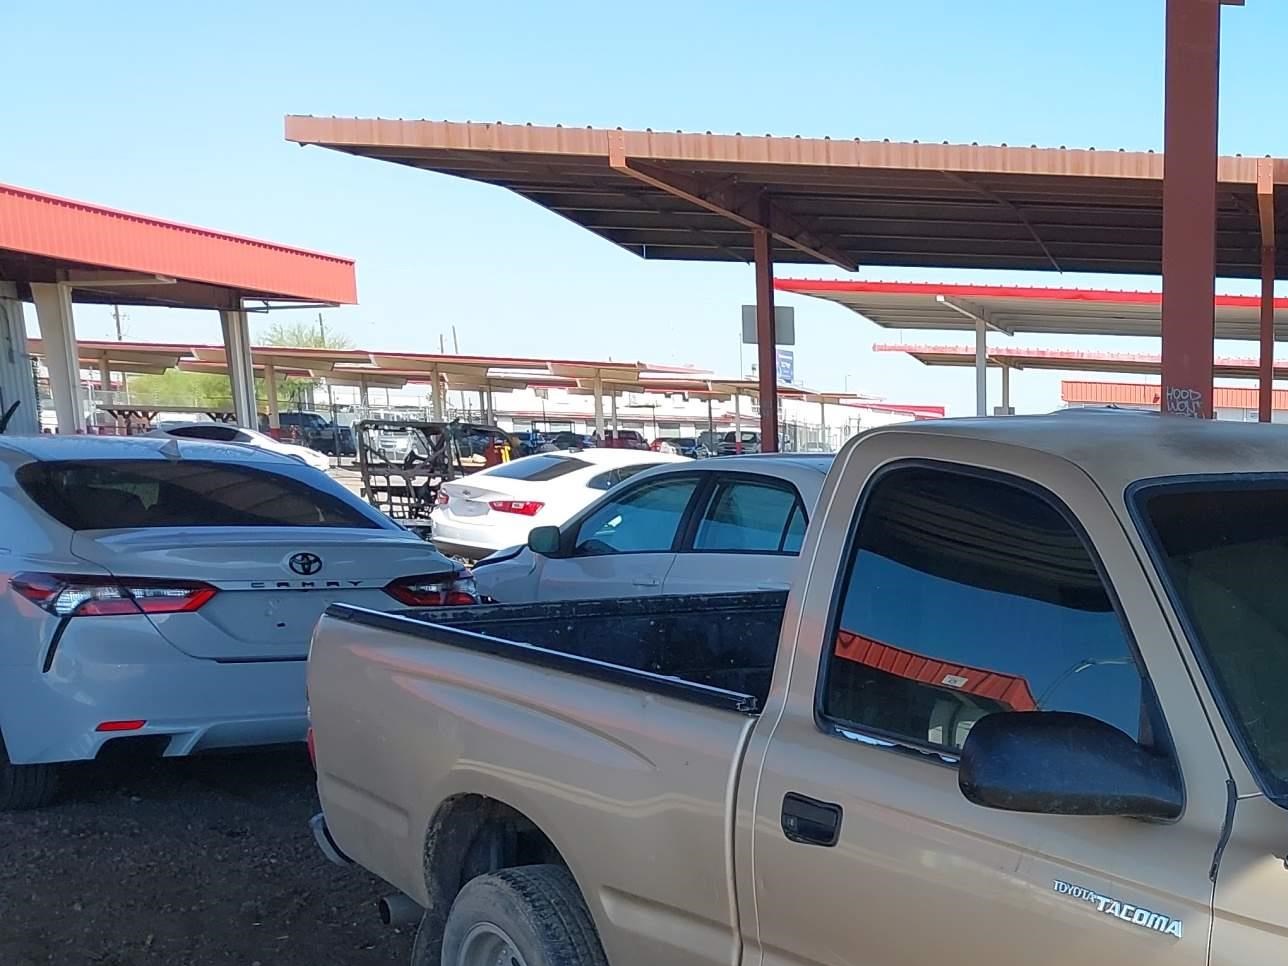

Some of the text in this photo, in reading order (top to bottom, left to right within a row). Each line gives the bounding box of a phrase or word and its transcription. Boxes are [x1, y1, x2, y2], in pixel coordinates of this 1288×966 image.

[1166, 385, 1202, 401] HOOD
[251, 580, 363, 588] CAMRY
[1053, 880, 1183, 938] TOYOTA TACOMA
